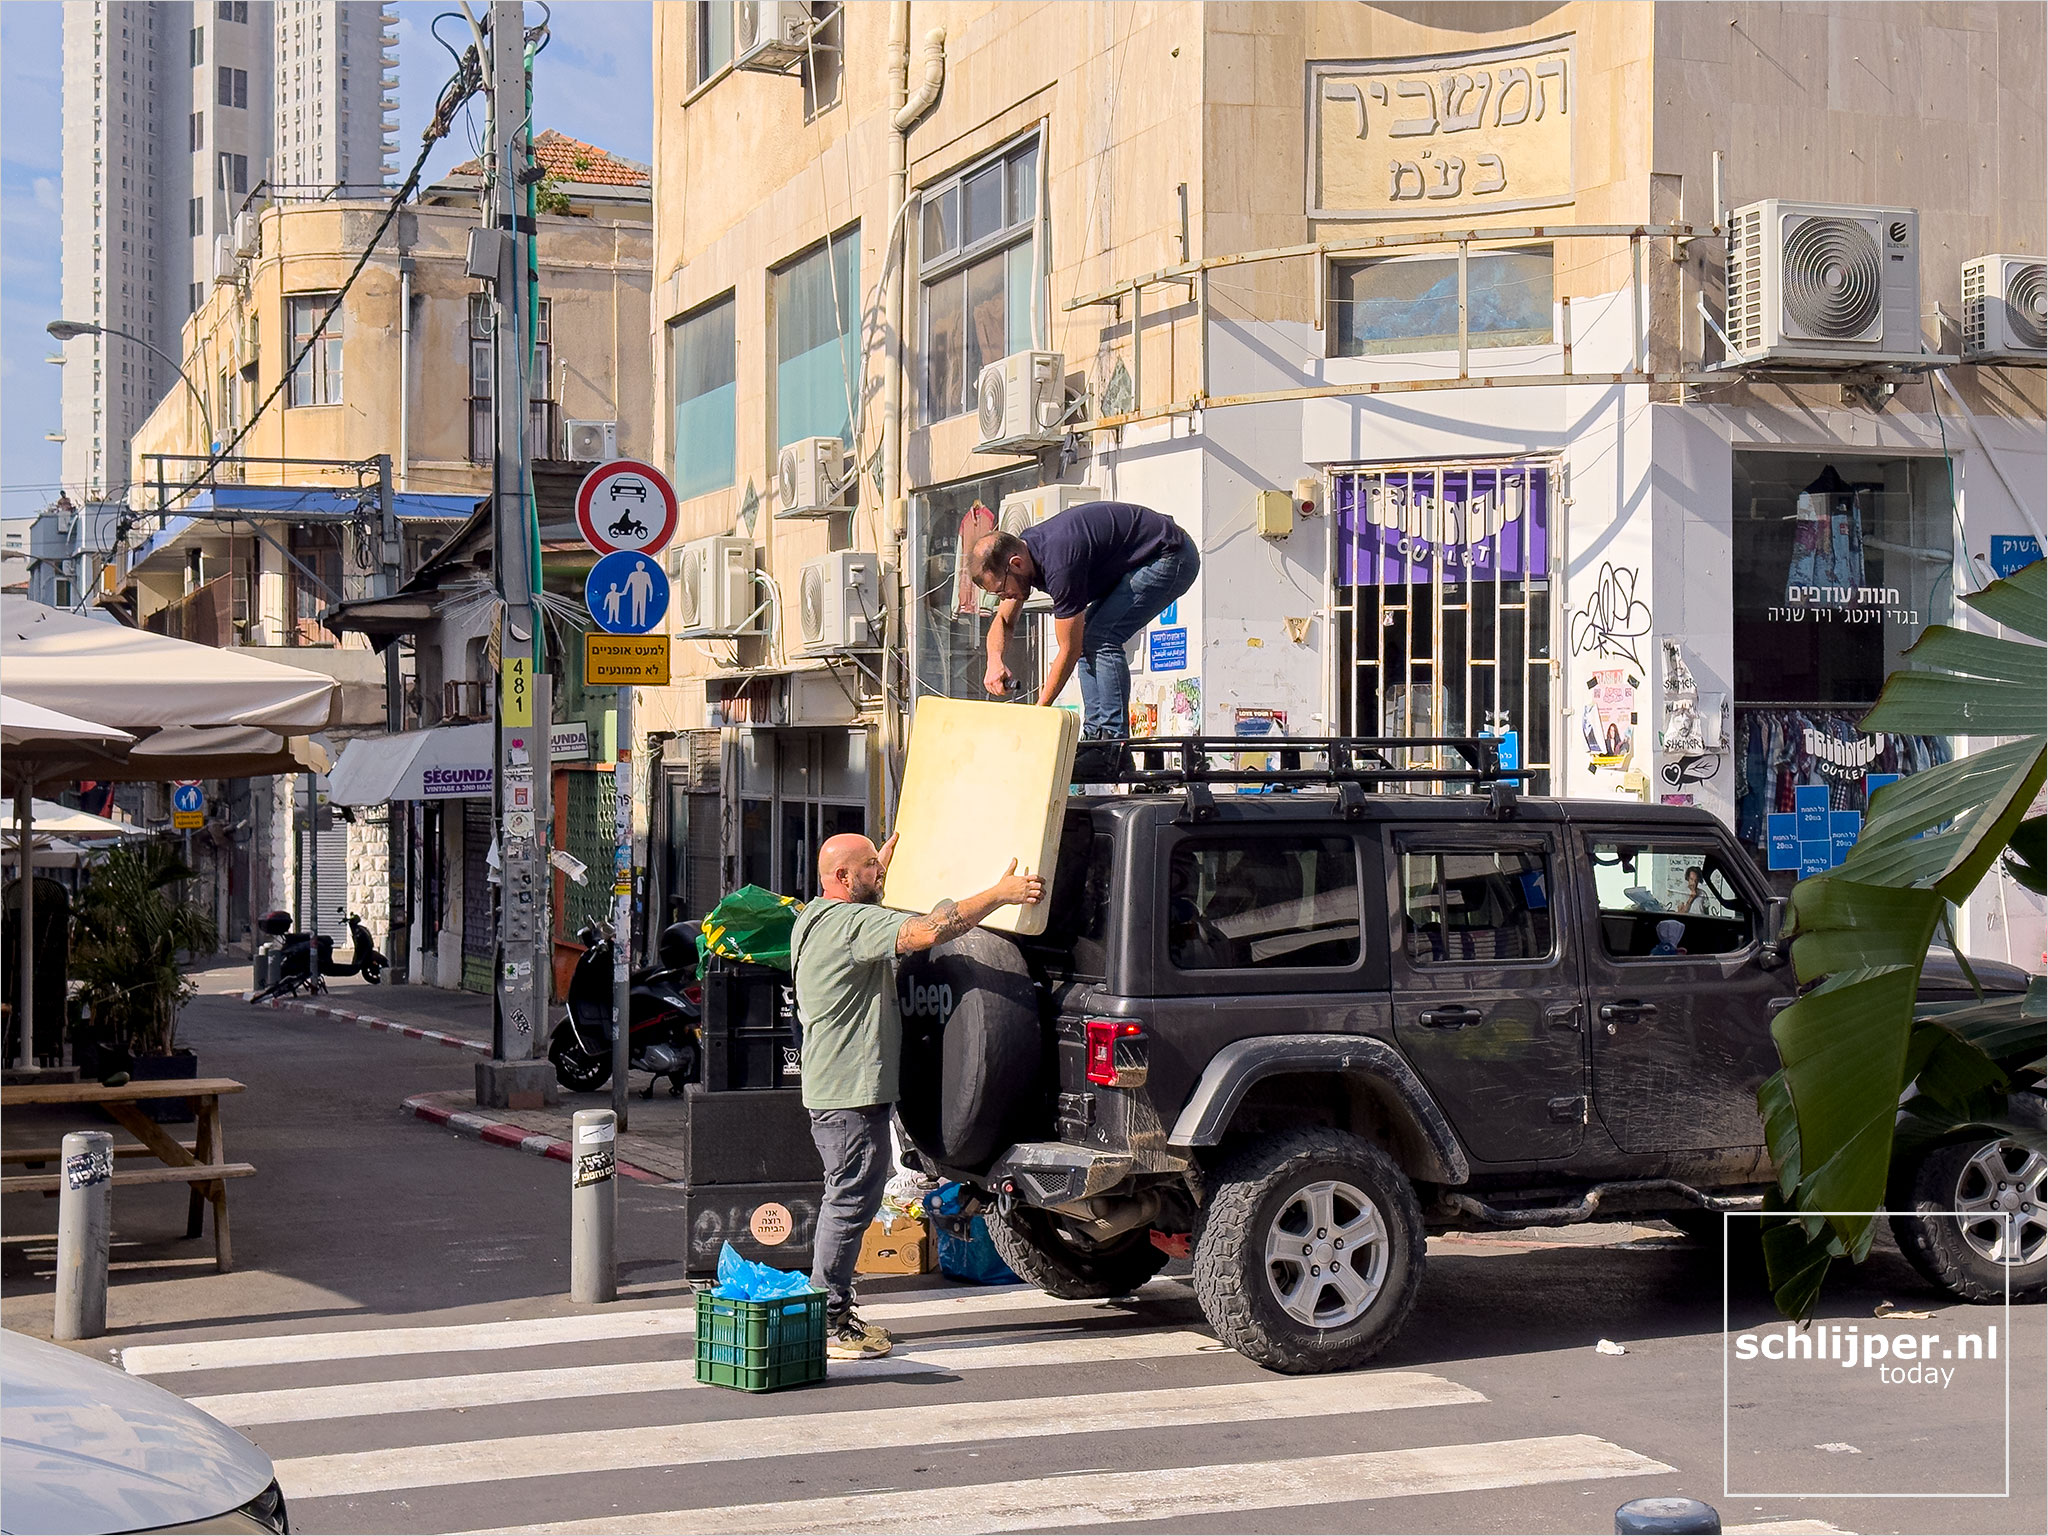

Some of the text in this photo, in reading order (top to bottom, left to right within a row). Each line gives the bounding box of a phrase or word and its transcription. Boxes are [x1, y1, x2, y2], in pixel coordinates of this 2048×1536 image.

[1325, 58, 1568, 140] המשביר
[1397, 537, 1490, 568] OULET
[2002, 540, 2040, 555] השוק
[1788, 585, 1900, 605] חנות עודפים
[1768, 606, 1806, 623] שניה
[1811, 607, 1832, 623] ויד
[1887, 609, 1919, 625] בגדי
[592, 644, 665, 656] למעט אופניים
[597, 664, 659, 675] לא ממונעים
[513, 658, 525, 713] 481
[1821, 762, 1867, 781] OUTLET
[476, 783, 492, 791] HAN
[901, 974, 953, 1024] Jeep
[765, 1209, 778, 1217] אני
[757, 1225, 785, 1233] הביתה
